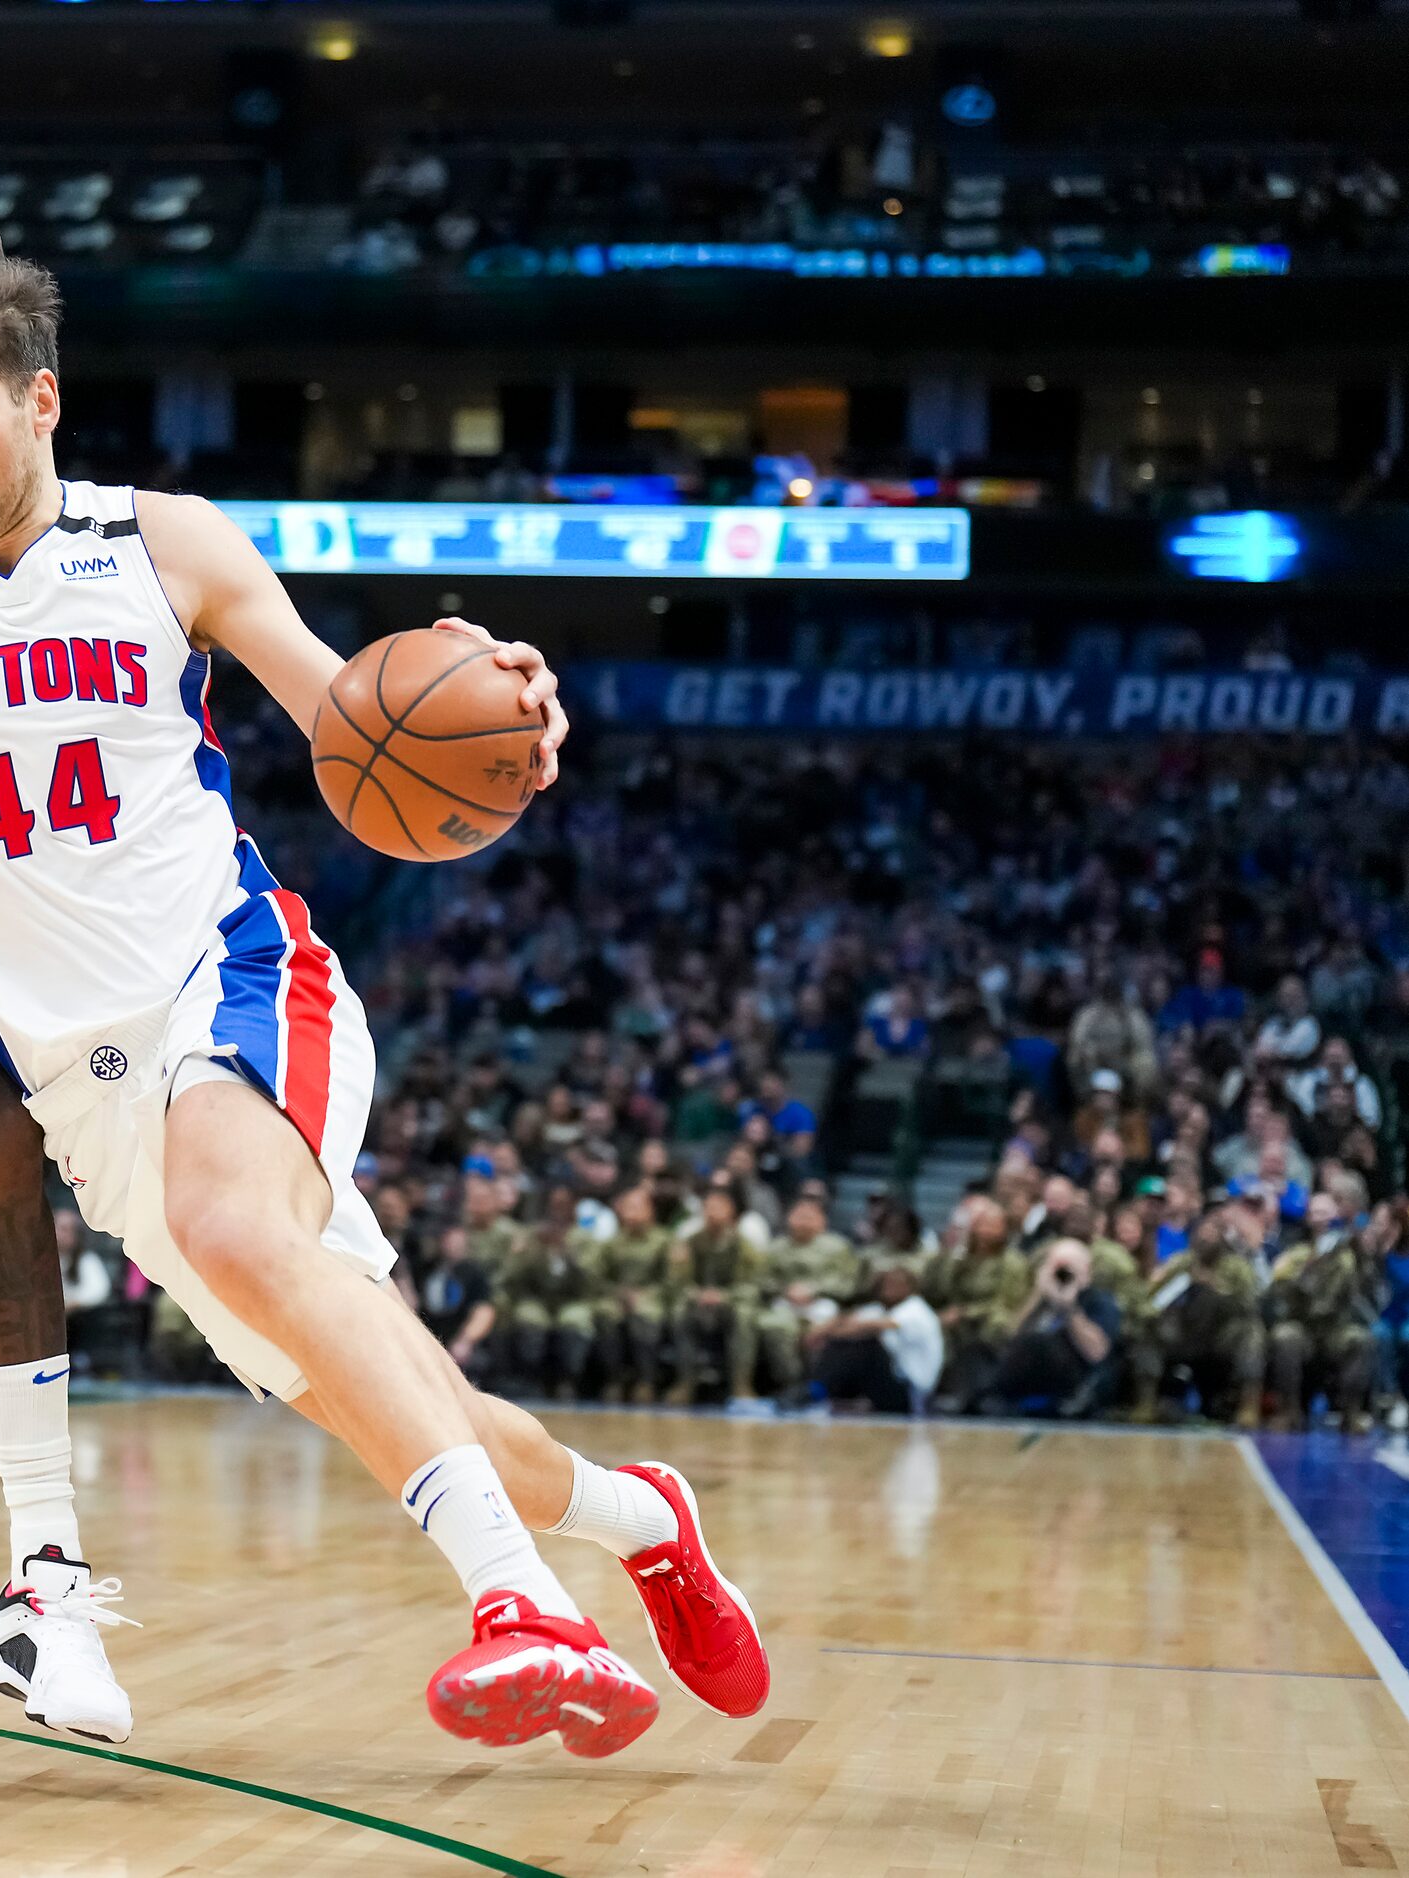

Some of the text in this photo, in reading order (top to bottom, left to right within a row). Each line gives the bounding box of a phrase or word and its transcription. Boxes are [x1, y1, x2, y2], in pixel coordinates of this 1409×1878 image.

[88, 518, 106, 538] 16
[59, 555, 118, 576] UWM
[666, 671, 801, 725] GET
[1110, 674, 1355, 734] PROUD
